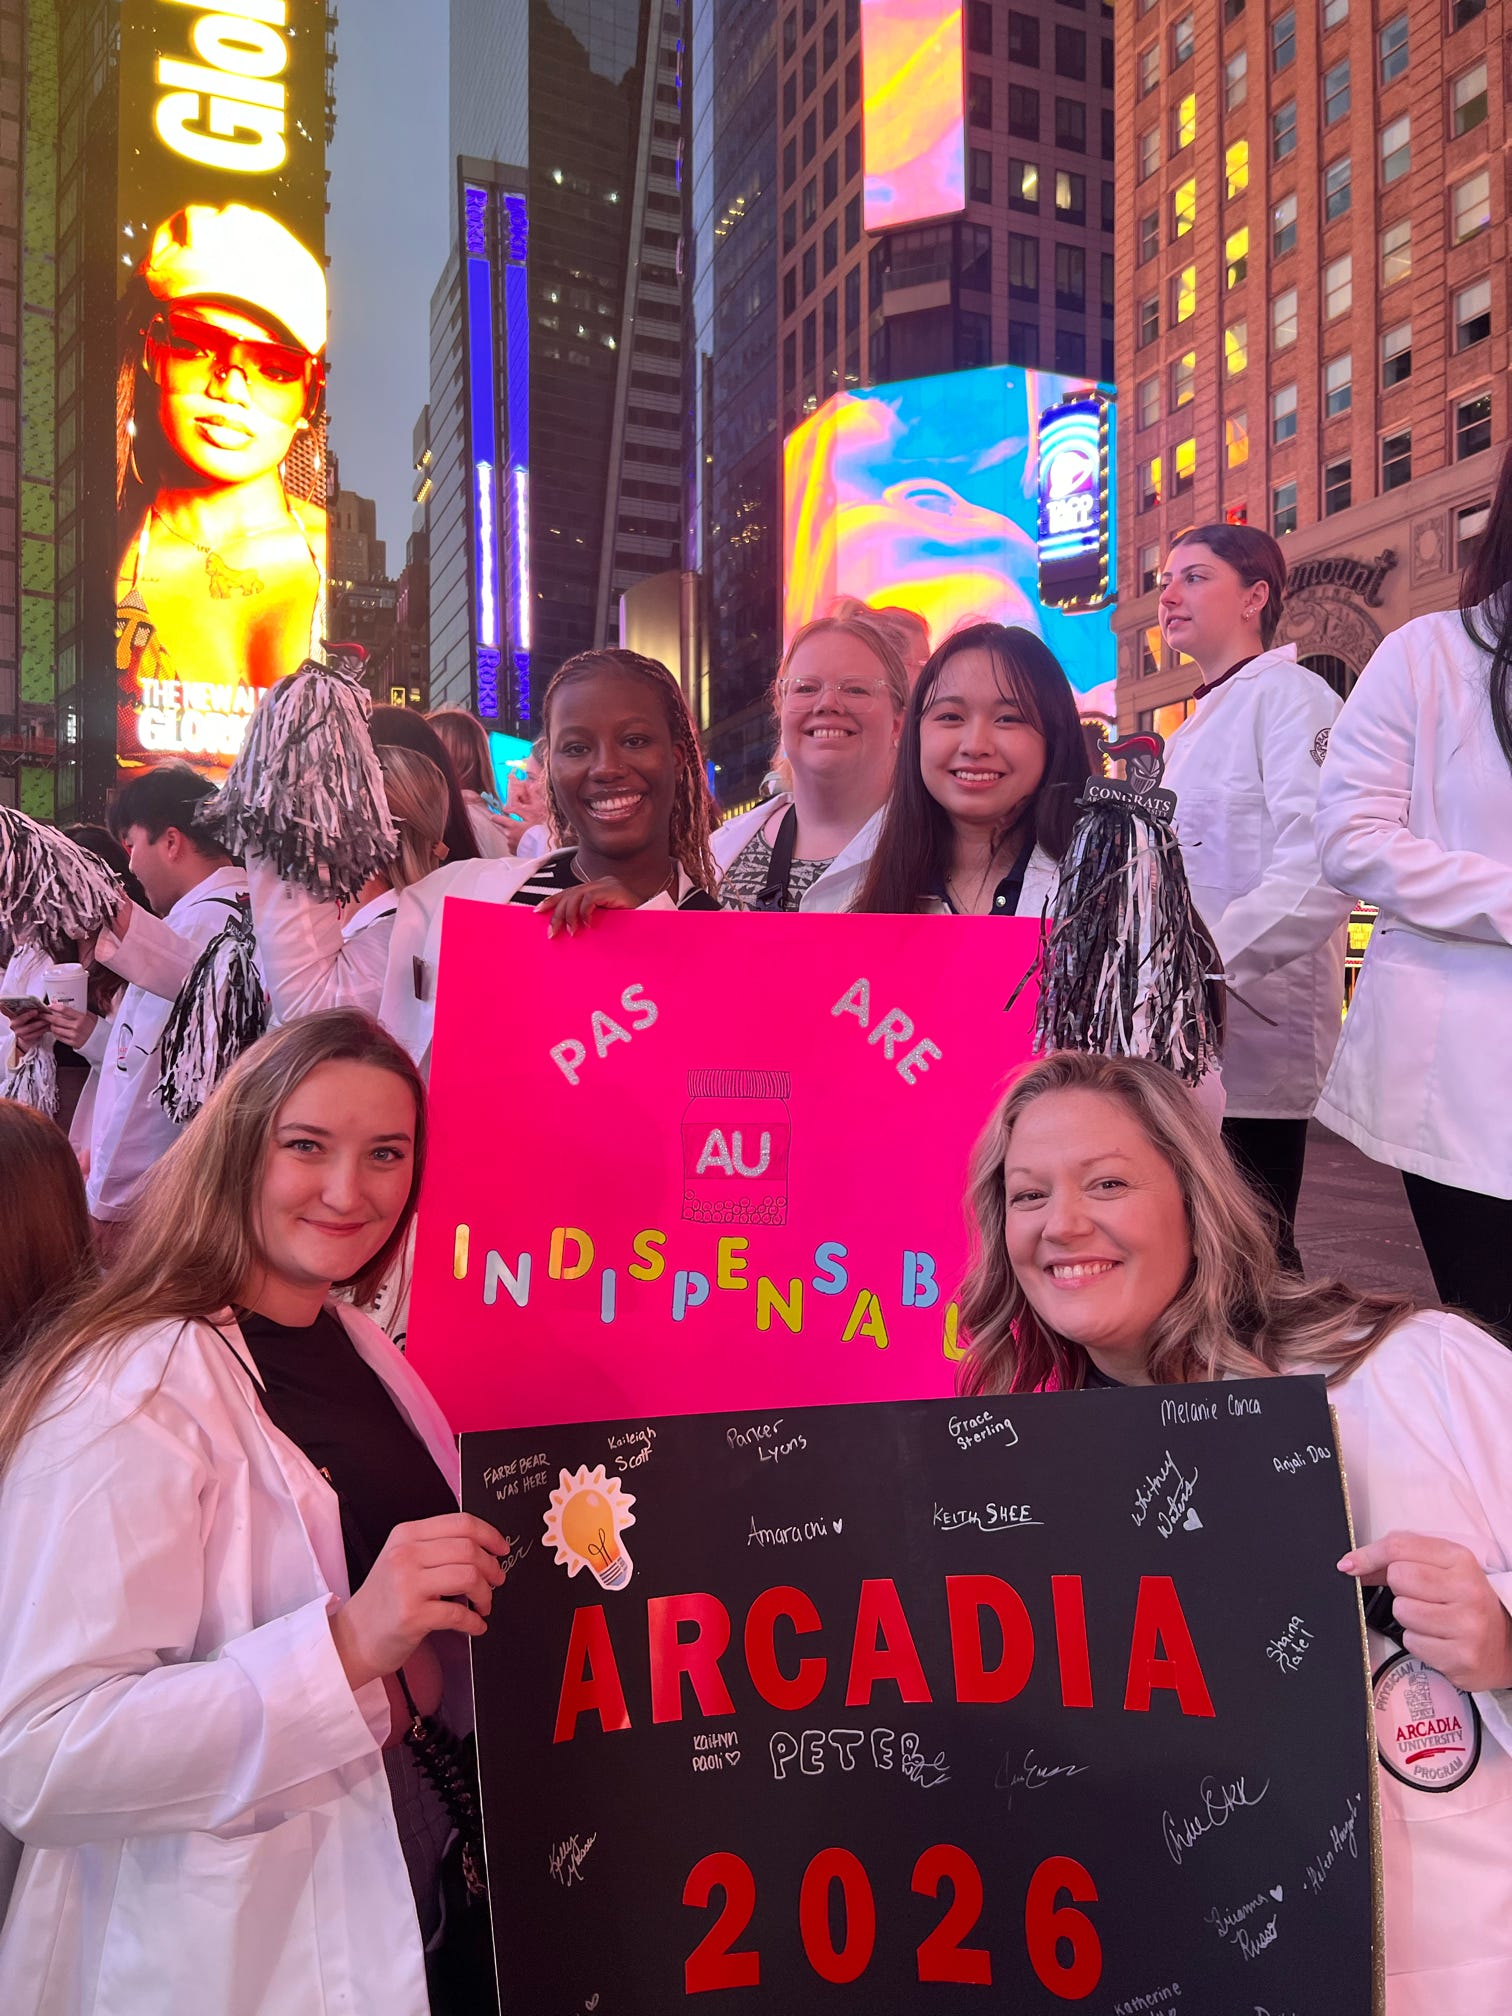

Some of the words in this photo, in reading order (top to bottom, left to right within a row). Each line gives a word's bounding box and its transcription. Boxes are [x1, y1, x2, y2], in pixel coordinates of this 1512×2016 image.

[141, 677, 181, 709] THE
[183, 680, 233, 713] NEW
[1089, 785, 1172, 812] CONGRATS
[549, 983, 660, 1086] PAS
[830, 977, 943, 1086] ARE
[696, 1128, 772, 1177] AU
[453, 1223, 970, 1361] INDISPENSABL
[948, 1411, 994, 1437] Grace
[1161, 1398, 1218, 1427] Melanie
[608, 1426, 657, 1451] Kaileigh
[726, 1418, 784, 1449] Parker
[758, 1434, 808, 1463] Lyons
[957, 1418, 1019, 1451] Sterling
[519, 1452, 551, 1476] BEAR
[614, 1449, 653, 1472] Scott
[496, 1482, 520, 1501] WAS
[523, 1470, 549, 1494] HERE
[1131, 1449, 1184, 1527] Whitney
[933, 1501, 979, 1527] KEITH
[985, 1502, 1033, 1525] SHEE
[747, 1515, 828, 1548] Amarachi
[552, 1574, 1217, 1744] ARCADIA
[1375, 1661, 1415, 1712] PHYSICIAN
[1395, 1715, 1463, 1742] ARCADIA
[1398, 1730, 1464, 1753] UNIVERSITY
[1413, 1756, 1464, 1780] PROGRAM
[682, 1843, 1103, 2000] 2026
[1230, 1913, 1279, 1962] Russo
[1113, 1981, 1184, 2016] Katherine
